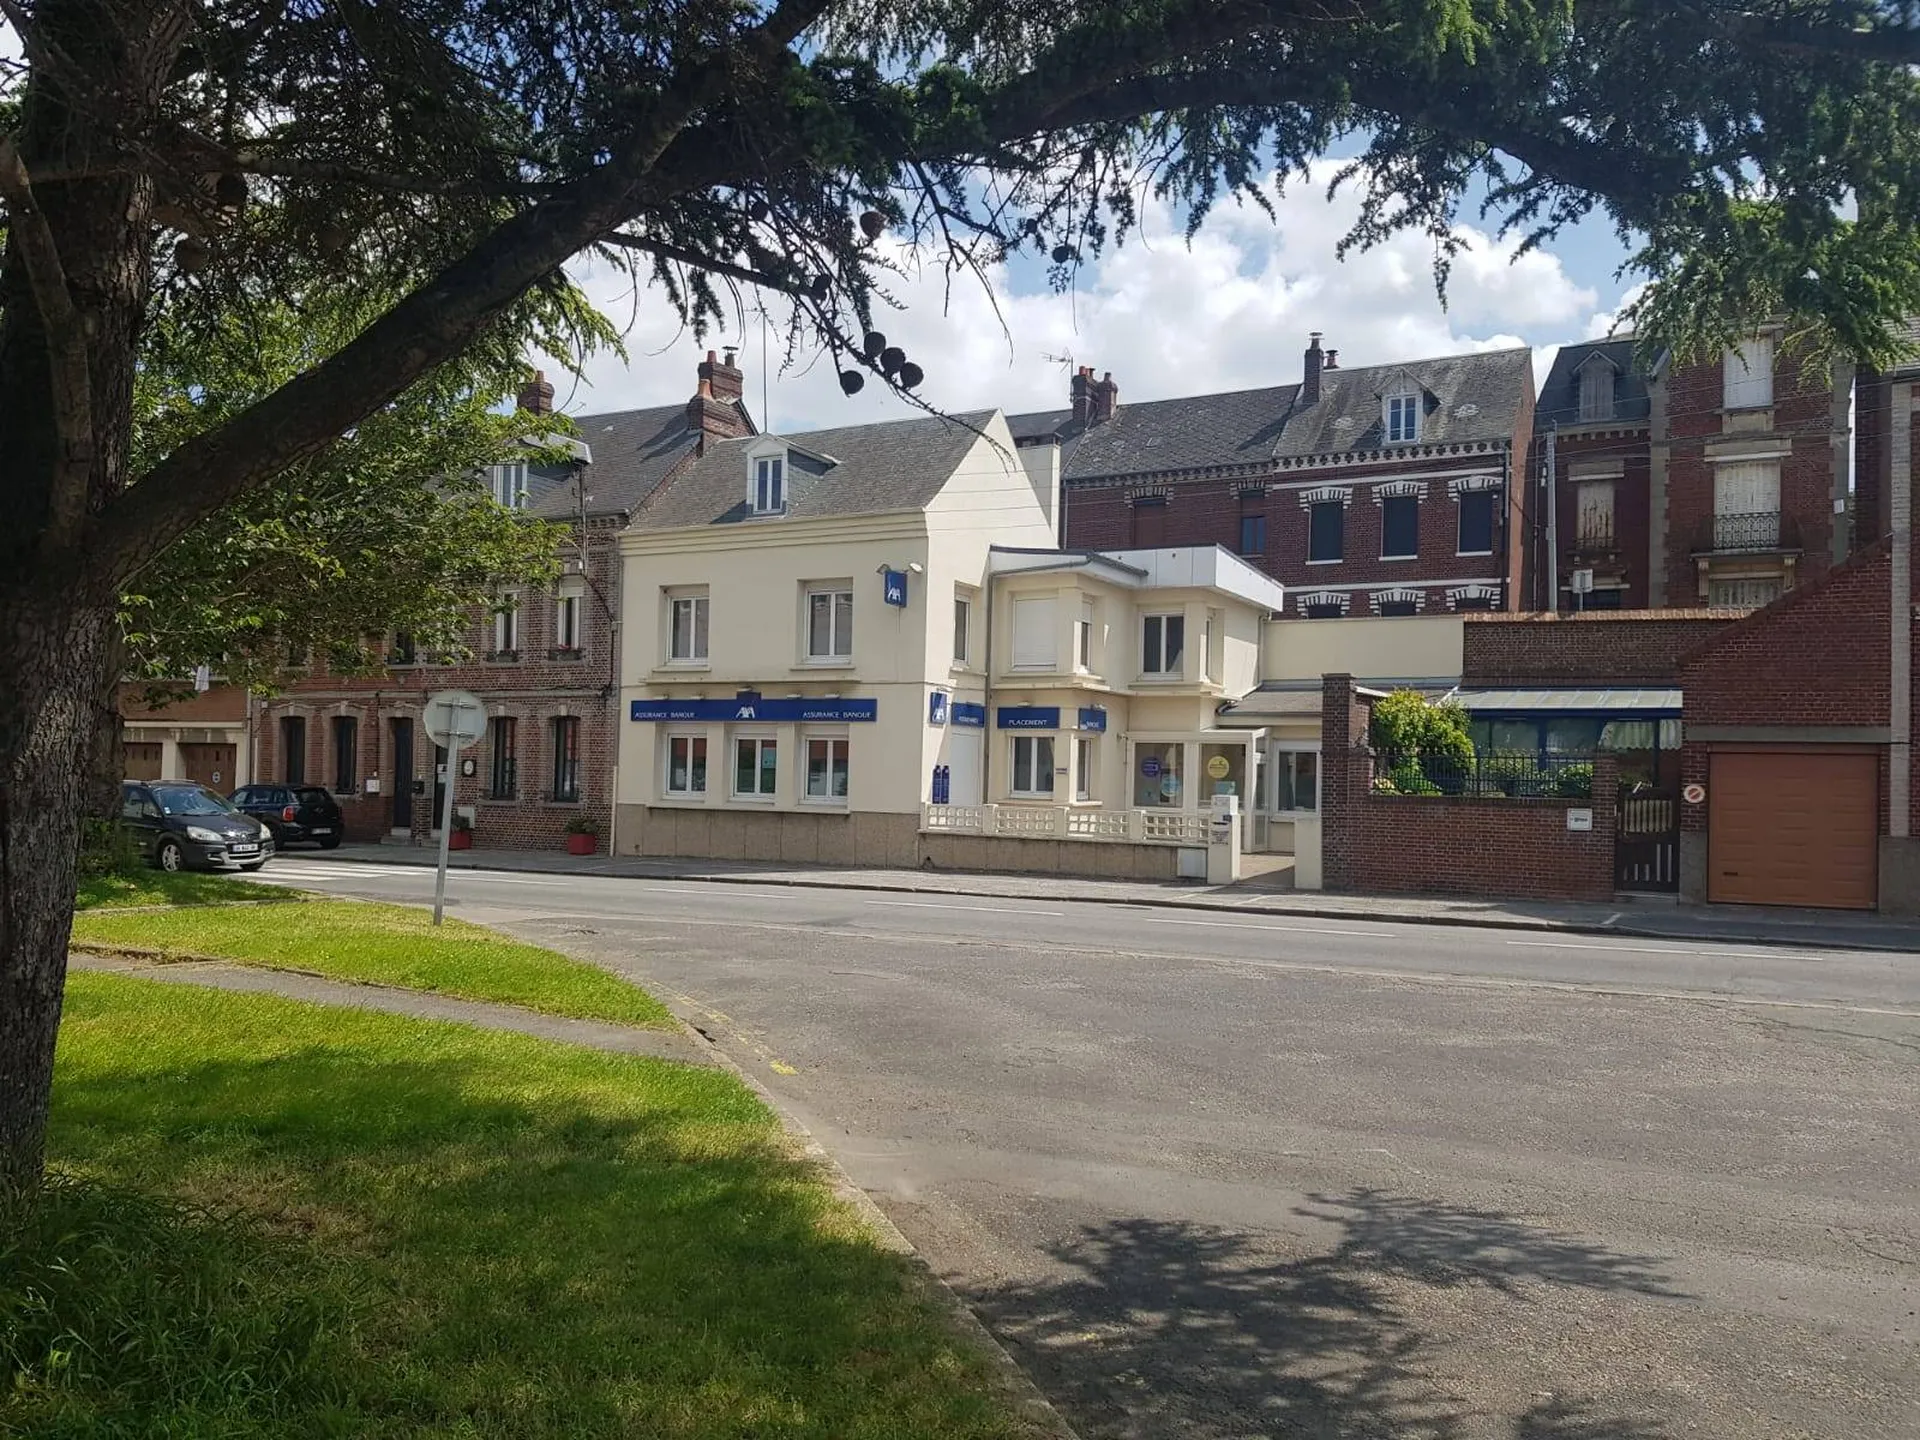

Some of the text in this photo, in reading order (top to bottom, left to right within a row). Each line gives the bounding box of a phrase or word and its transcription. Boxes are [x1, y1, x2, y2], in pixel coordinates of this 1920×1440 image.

[887, 587, 901, 602] AXA
[634, 711, 696, 719] ASSURANCE BANQUE
[736, 706, 755, 719] AXA
[802, 711, 872, 719] ASSURANCE BANQUE
[1008, 719, 1048, 727] PLACEMENT
